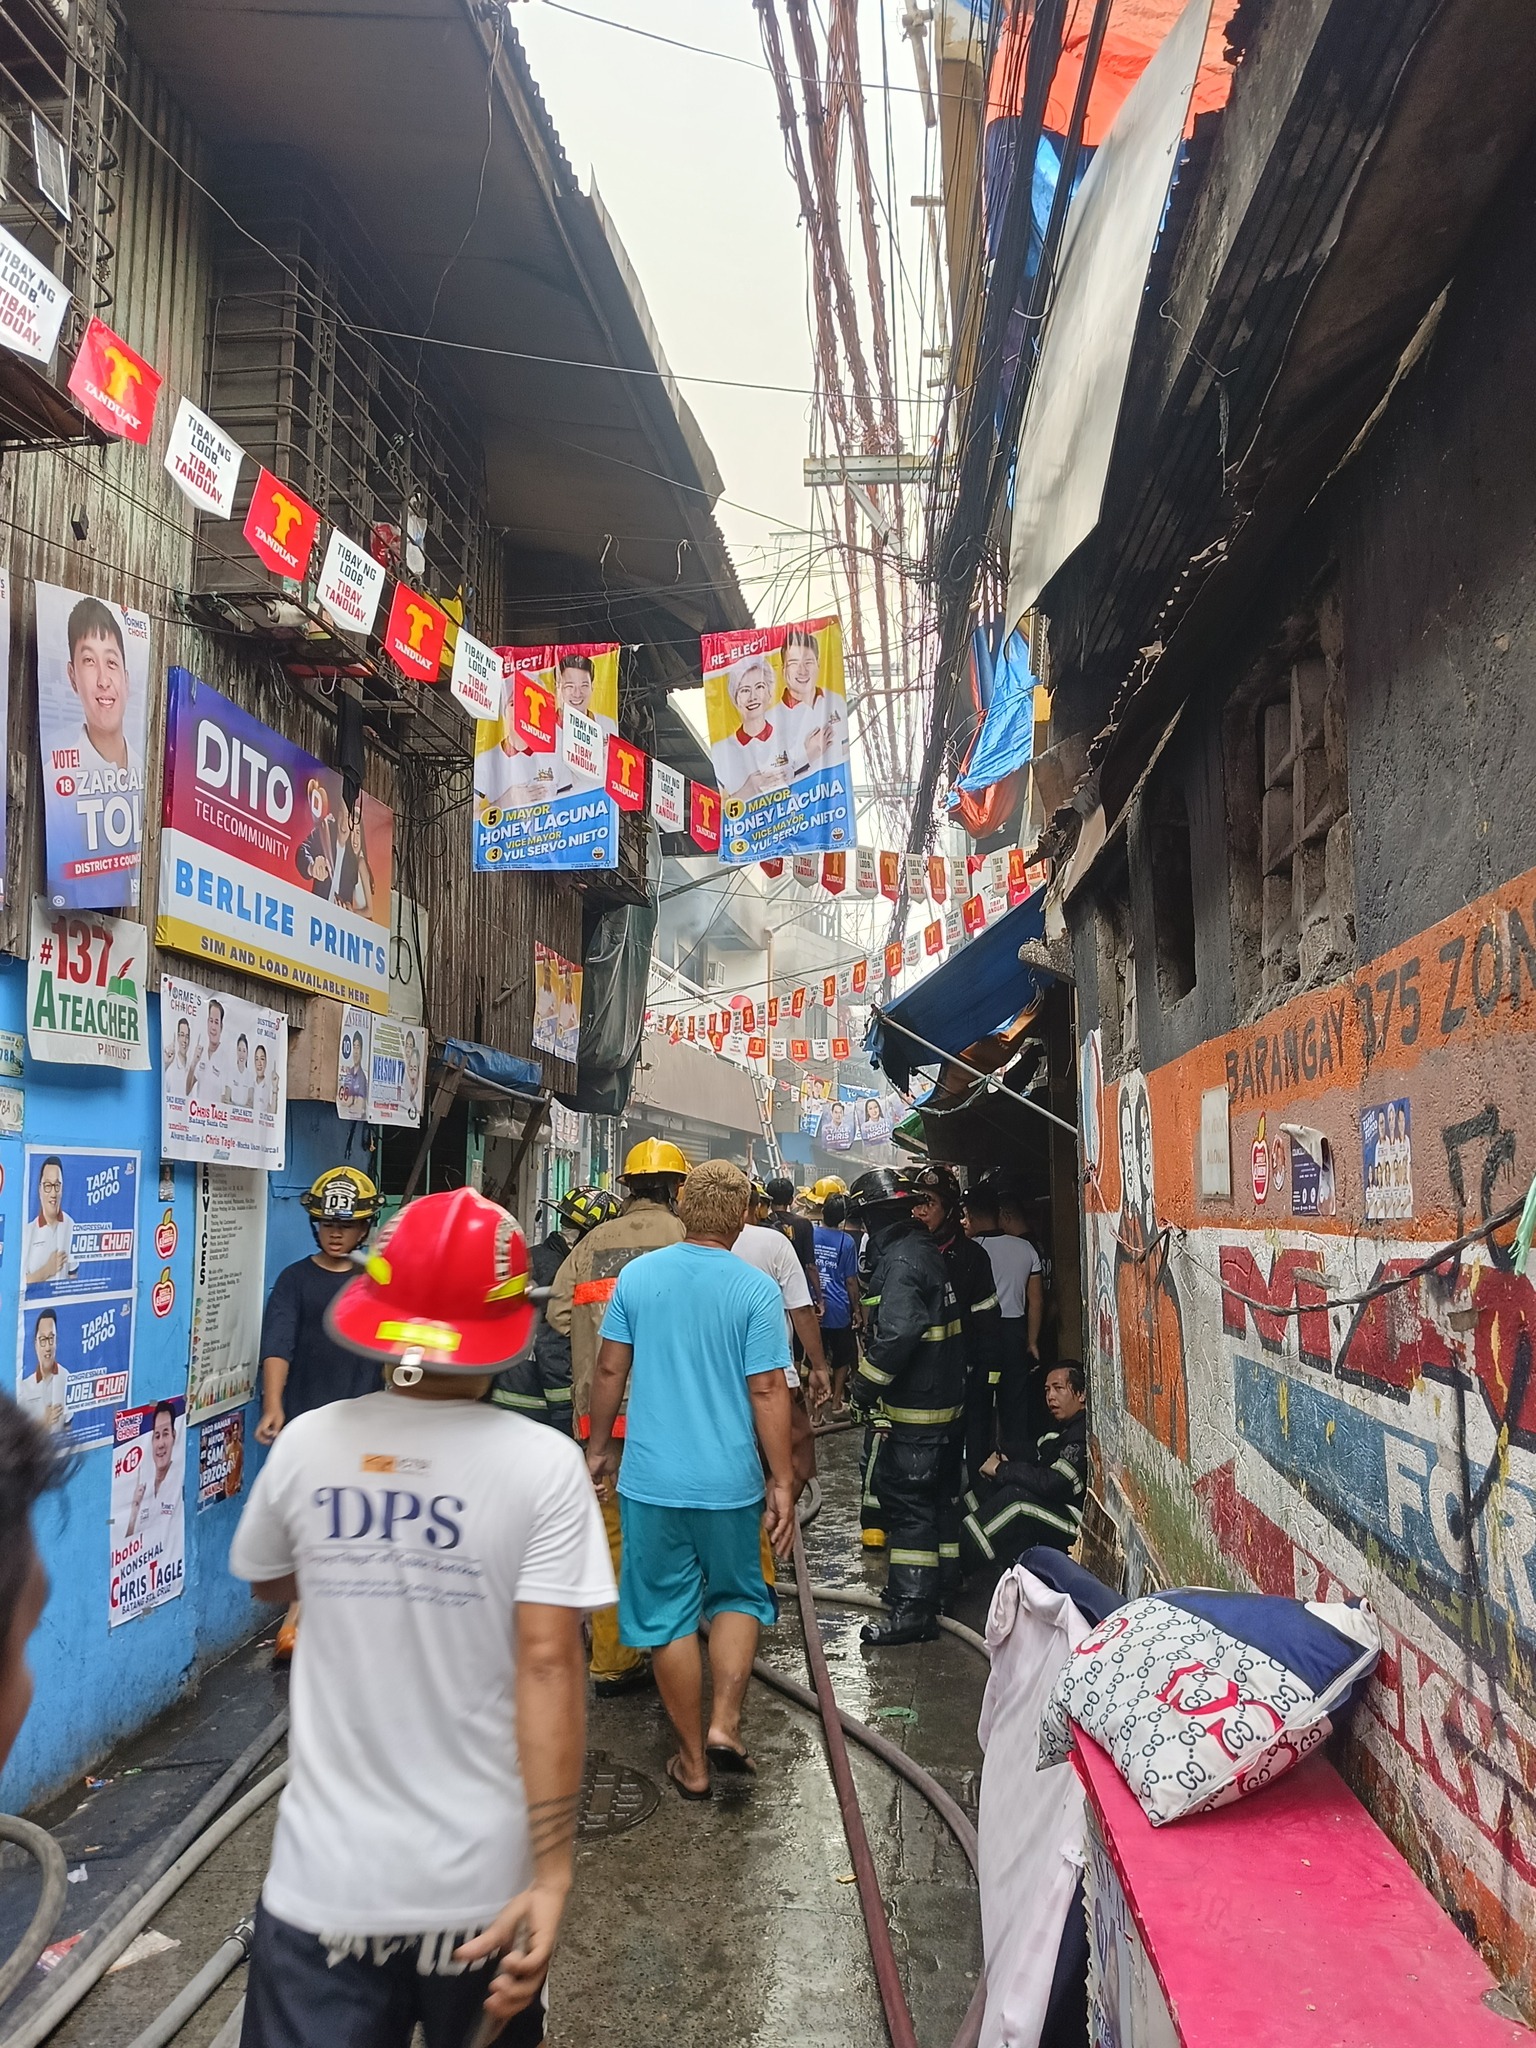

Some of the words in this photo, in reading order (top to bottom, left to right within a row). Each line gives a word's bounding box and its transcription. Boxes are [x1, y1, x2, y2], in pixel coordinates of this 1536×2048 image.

[1, 265, 41, 309] LOOB.
[37, 278, 57, 304] NG
[83, 379, 142, 430] TANDUAY
[187, 413, 217, 447] TIBAY
[217, 442, 232, 463] NG
[190, 434, 221, 471] LOOB.
[173, 455, 225, 510] TANDUAY.
[188, 451, 218, 484] TIBAY
[253, 525, 300, 569] TANDUAY
[337, 542, 363, 569] TIBAY
[363, 565, 377, 582] NG
[339, 560, 366, 590] LOOB.
[325, 584, 368, 626] TANDUAY.
[337, 578, 363, 607] TIBAY
[128, 627, 148, 640] CHOICE
[394, 637, 434, 671] TANDUAY
[463, 641, 486, 664] TIBAY
[485, 656, 498, 673] NG
[710, 634, 770, 667] RE-ELECT!
[467, 657, 490, 681] LOOB.
[467, 673, 488, 696] TIBAY
[457, 680, 496, 714] TANDUAY.
[519, 719, 552, 744] TANDUAY
[568, 713, 589, 733] TIBAY
[588, 724, 599, 739] NG
[572, 727, 594, 747] LOOB.
[52, 748, 81, 770] VOTE!
[566, 750, 600, 777] TANDUAY.
[573, 742, 593, 762] TIBAY
[58, 779, 73, 793] 18
[195, 718, 294, 824] DITO
[610, 779, 640, 802] TANDUAY
[728, 800, 740, 818] 5
[747, 787, 792, 814] MAYOR
[479, 820, 533, 847] HONEY
[533, 799, 610, 832] LACUNA
[487, 809, 498, 827] 5
[505, 803, 551, 822] MAYOR
[723, 807, 779, 839] HONEY
[777, 779, 845, 820] LACUNA
[194, 797, 290, 861] TELECOMMUNITY
[505, 838, 528, 850] VICE
[527, 830, 563, 845] MAYOR
[735, 840, 745, 853] 3
[750, 836, 775, 855] YUL
[773, 821, 810, 845] SERVO
[809, 805, 848, 827] NIETO
[751, 824, 774, 842] VICE
[771, 813, 806, 834] MAYOR
[490, 848, 499, 861] 3
[503, 847, 527, 863] YUL
[526, 838, 568, 857] SERVO
[567, 825, 610, 848] NIETO
[74, 857, 113, 875] DISTRICT
[113, 858, 119, 868] 3
[175, 857, 294, 938] BERLIZE
[309, 915, 387, 976] PRINTS
[39, 914, 115, 988] #137
[200, 935, 227, 958] SIM
[229, 944, 255, 968] AND
[259, 953, 289, 978] LOAD
[292, 967, 346, 1000] AVAILABLE
[348, 984, 370, 1005] HERE
[1224, 998, 1346, 1105] BARANGAY
[210, 1103, 228, 1121] TAGLE
[825, 1132, 850, 1141] CHRIS
[86, 1165, 121, 1191] TAPAT
[86, 1181, 120, 1206] TOTOO
[71, 1232, 100, 1253] JOEL
[101, 1231, 131, 1251] CHUA
[81, 1308, 116, 1339] TAPAT
[81, 1324, 116, 1354] TOTOO
[66, 1383, 95, 1404] JOEL
[94, 1375, 127, 1398] CHUA
[116, 1425, 141, 1442] CHOICE
[206, 1445, 224, 1467] SAM
[310, 1485, 468, 1550] DPS
[110, 1533, 144, 1569] Iboto!
[119, 1541, 164, 1582] KONSEHAL
[110, 1574, 148, 1609] CHRIS
[149, 1559, 184, 1594] TAGLE
[121, 1596, 146, 1615] BATANG
[156, 1583, 172, 1599] CRUZ
